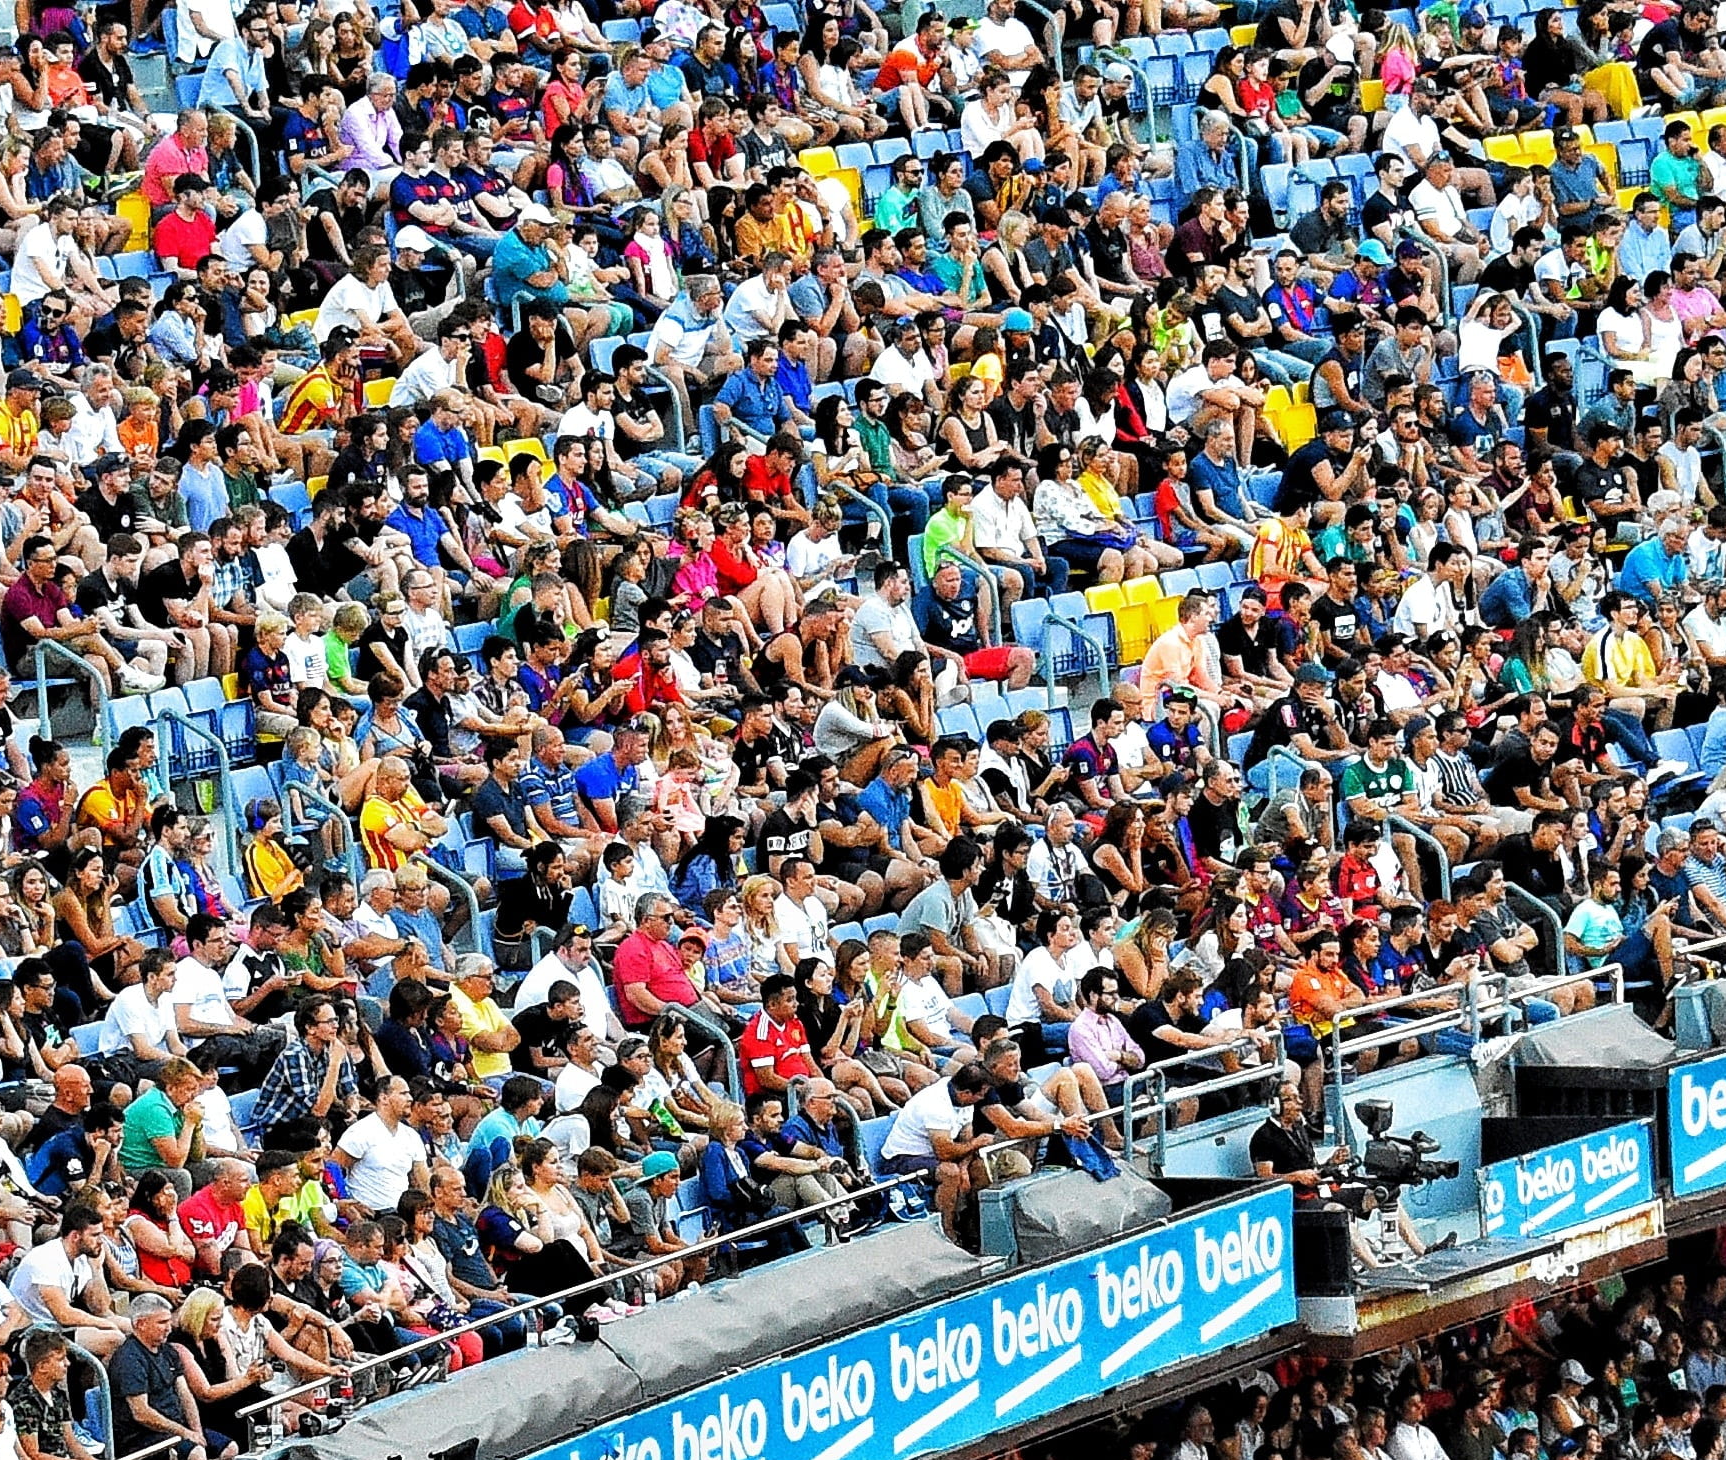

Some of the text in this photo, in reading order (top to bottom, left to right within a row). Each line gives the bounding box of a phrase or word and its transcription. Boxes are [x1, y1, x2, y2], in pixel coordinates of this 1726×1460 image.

[1515, 1154, 1576, 1206] beko
[1581, 1134, 1639, 1185] beko
[189, 1218, 215, 1235] 54
[781, 1354, 875, 1443] beko
[890, 1316, 982, 1403] beko
[992, 1282, 1083, 1367] beko
[1097, 1244, 1184, 1329] beko
[1195, 1211, 1283, 1294] beko
